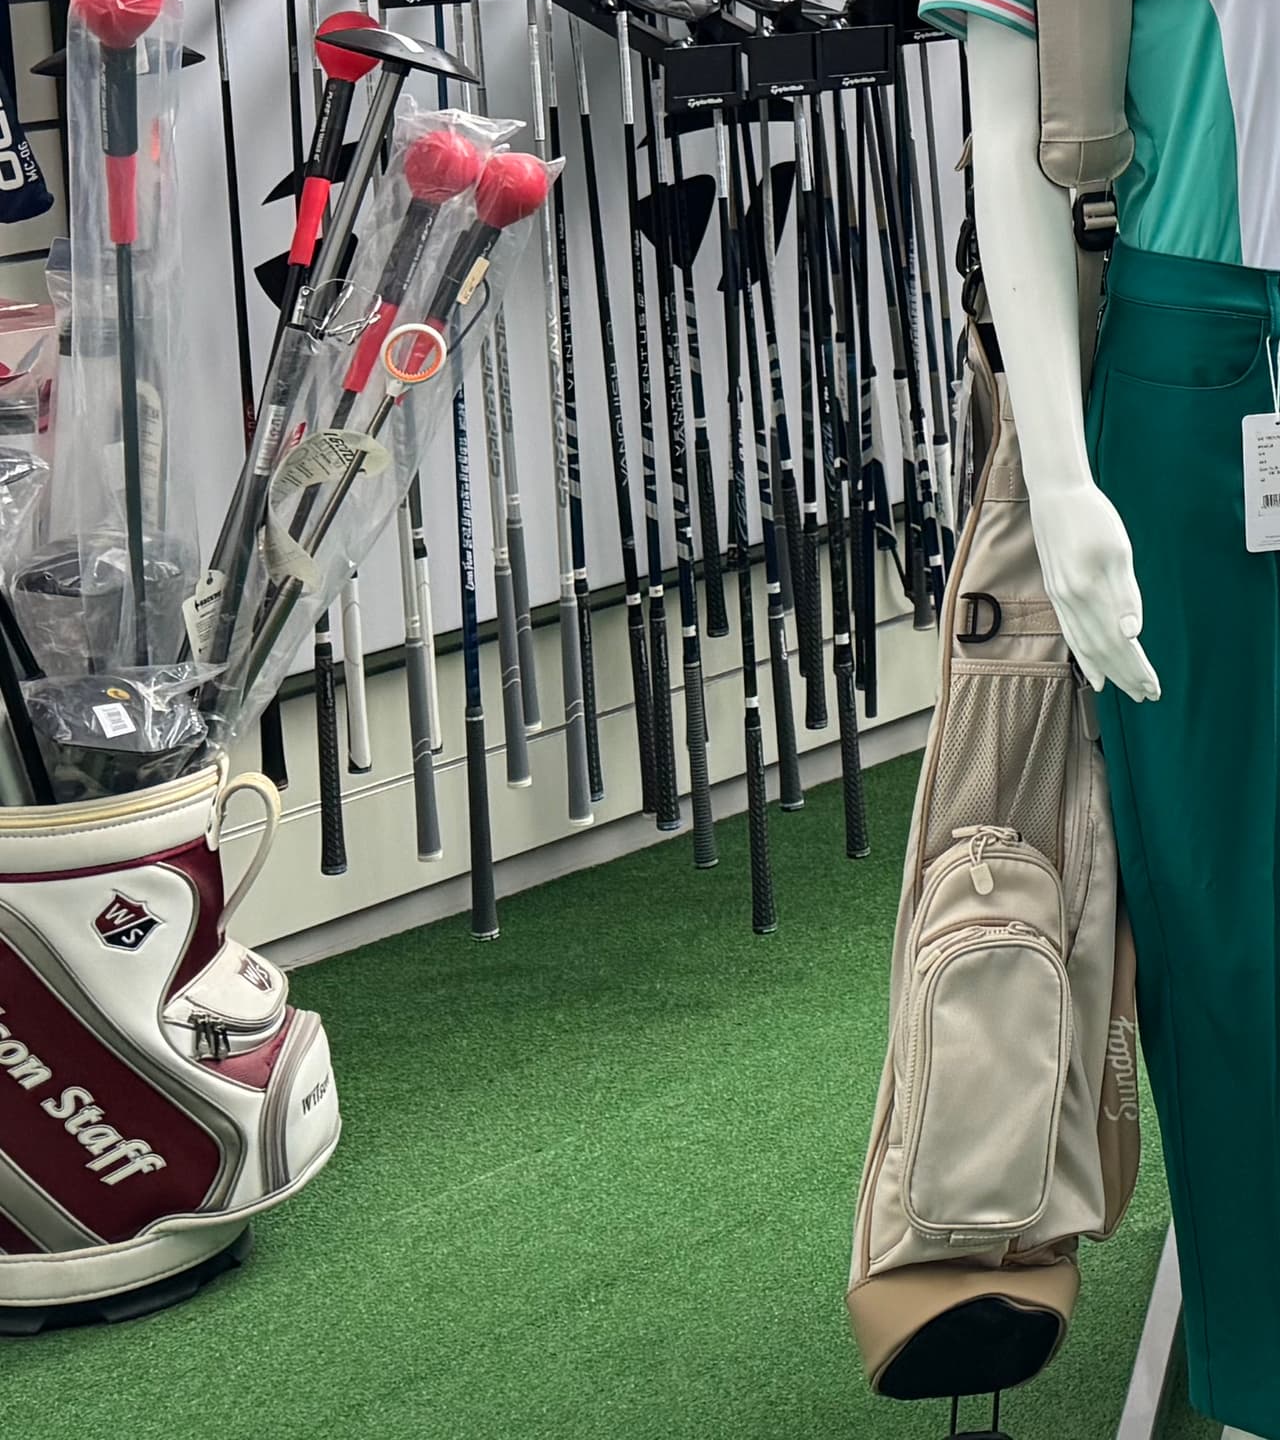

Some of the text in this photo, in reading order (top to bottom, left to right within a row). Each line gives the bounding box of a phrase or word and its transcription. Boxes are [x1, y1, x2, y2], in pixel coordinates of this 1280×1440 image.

[559, 295, 575, 392] VENTUS
[638, 312, 651, 411] VENTUS
[1103, 1015, 1138, 1121] Sunday
[39, 1086, 167, 1186] Staff
